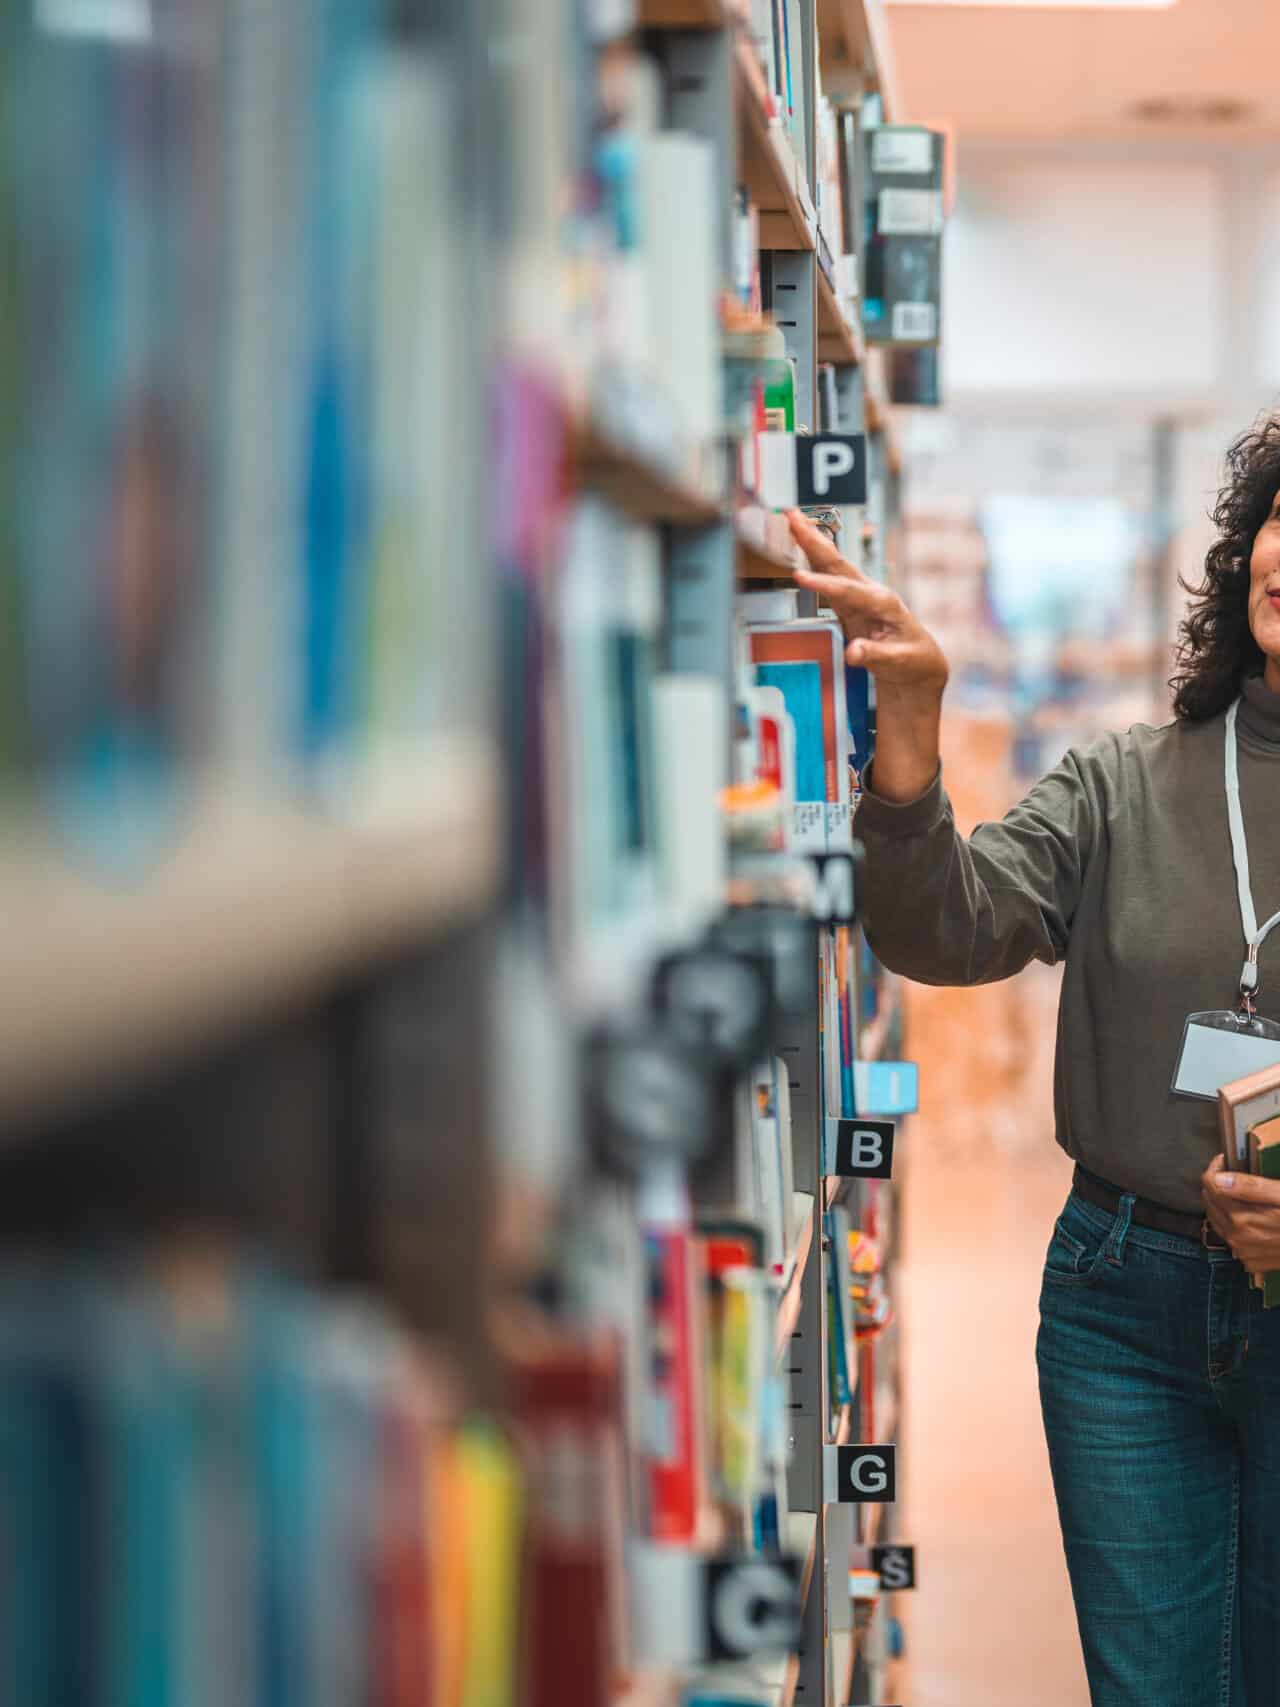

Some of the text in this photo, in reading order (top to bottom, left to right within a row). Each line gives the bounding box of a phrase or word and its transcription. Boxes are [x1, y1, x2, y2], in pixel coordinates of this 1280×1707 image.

[812, 441, 855, 496] P
[851, 1130, 883, 1168] B
[849, 1454, 888, 1493] G
[881, 1549, 910, 1588] Š
